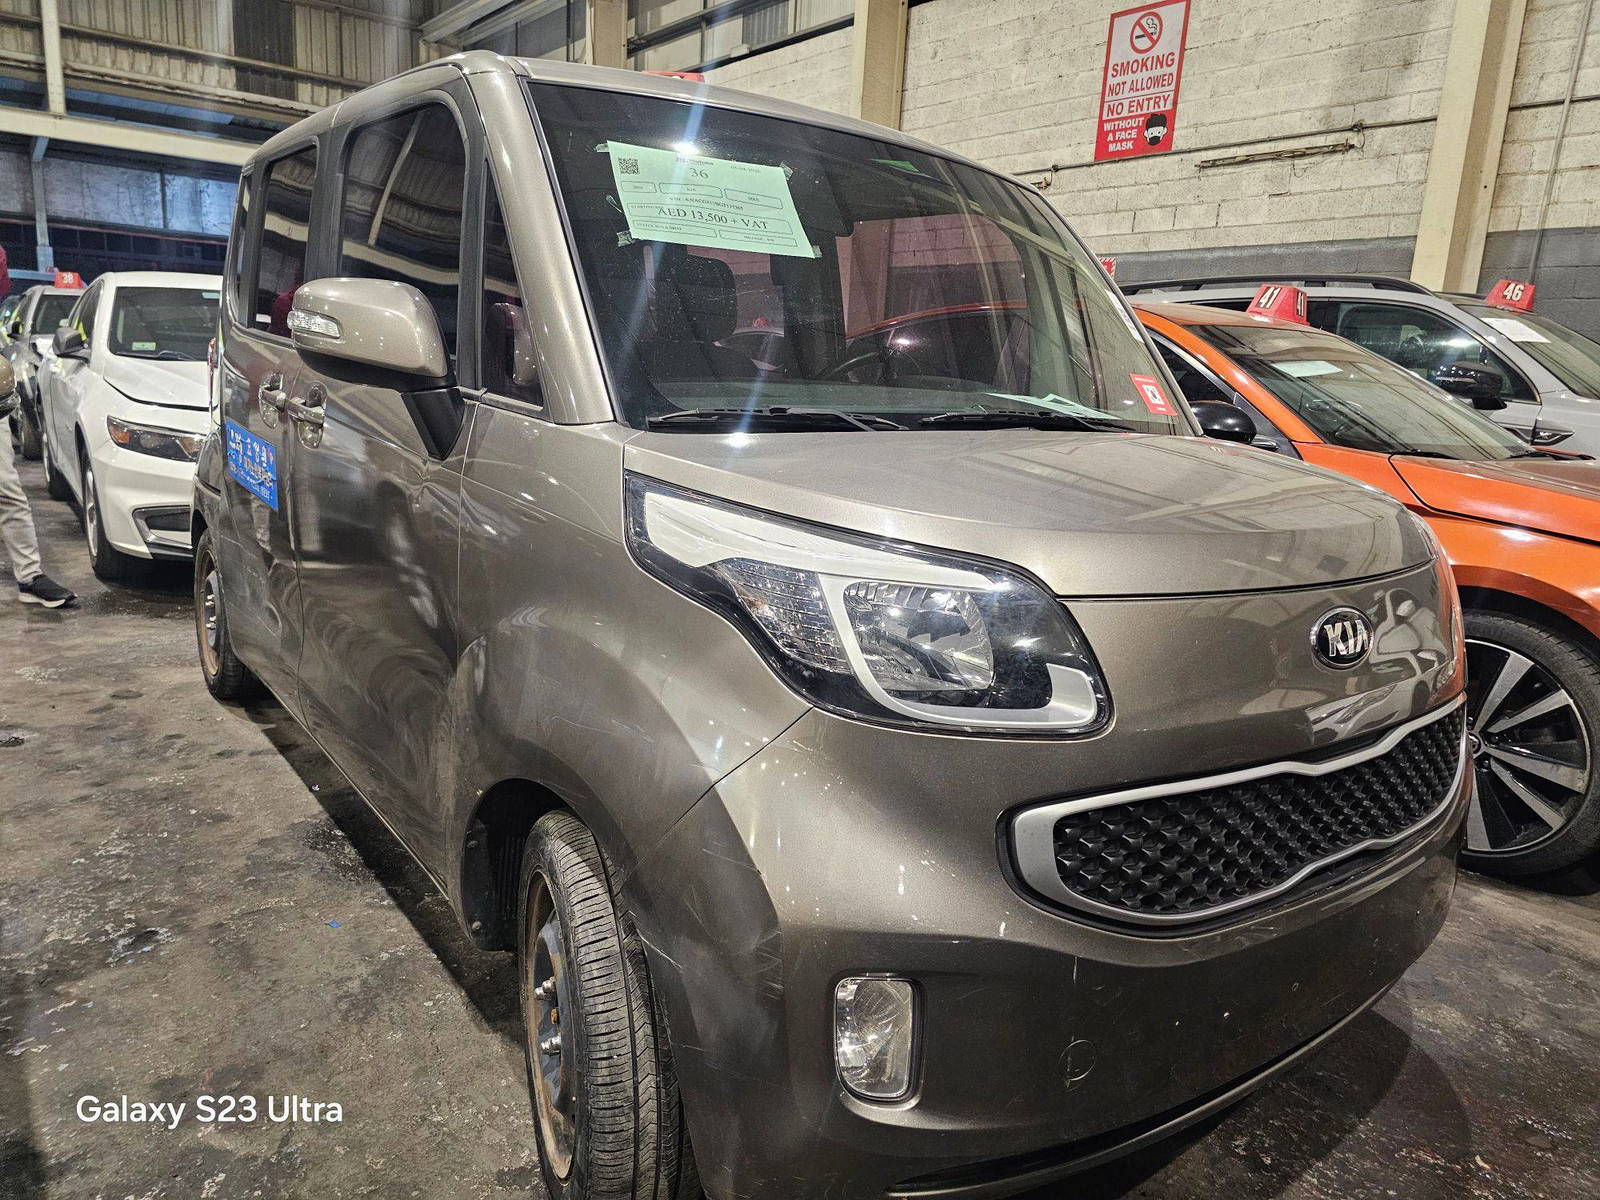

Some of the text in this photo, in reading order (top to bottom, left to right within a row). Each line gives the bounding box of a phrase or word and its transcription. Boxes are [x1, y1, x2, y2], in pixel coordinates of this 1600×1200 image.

[1111, 52, 1175, 78] SMOKING
[1108, 73, 1174, 97] NOT ALLOWED
[1106, 95, 1170, 118] NO ENTRY
[1104, 117, 1144, 131] WITHOUT
[1107, 129, 1137, 142] A FACE
[1109, 141, 1133, 152] MASK
[689, 167, 709, 179] 36
[657, 207, 687, 218] AED
[691, 209, 728, 224] 13,500
[741, 218, 768, 229] VAT
[1258, 286, 1282, 309] 41
[1503, 282, 1525, 301] 46
[1296, 291, 1305, 316] 41
[1323, 619, 1369, 657] KIA
